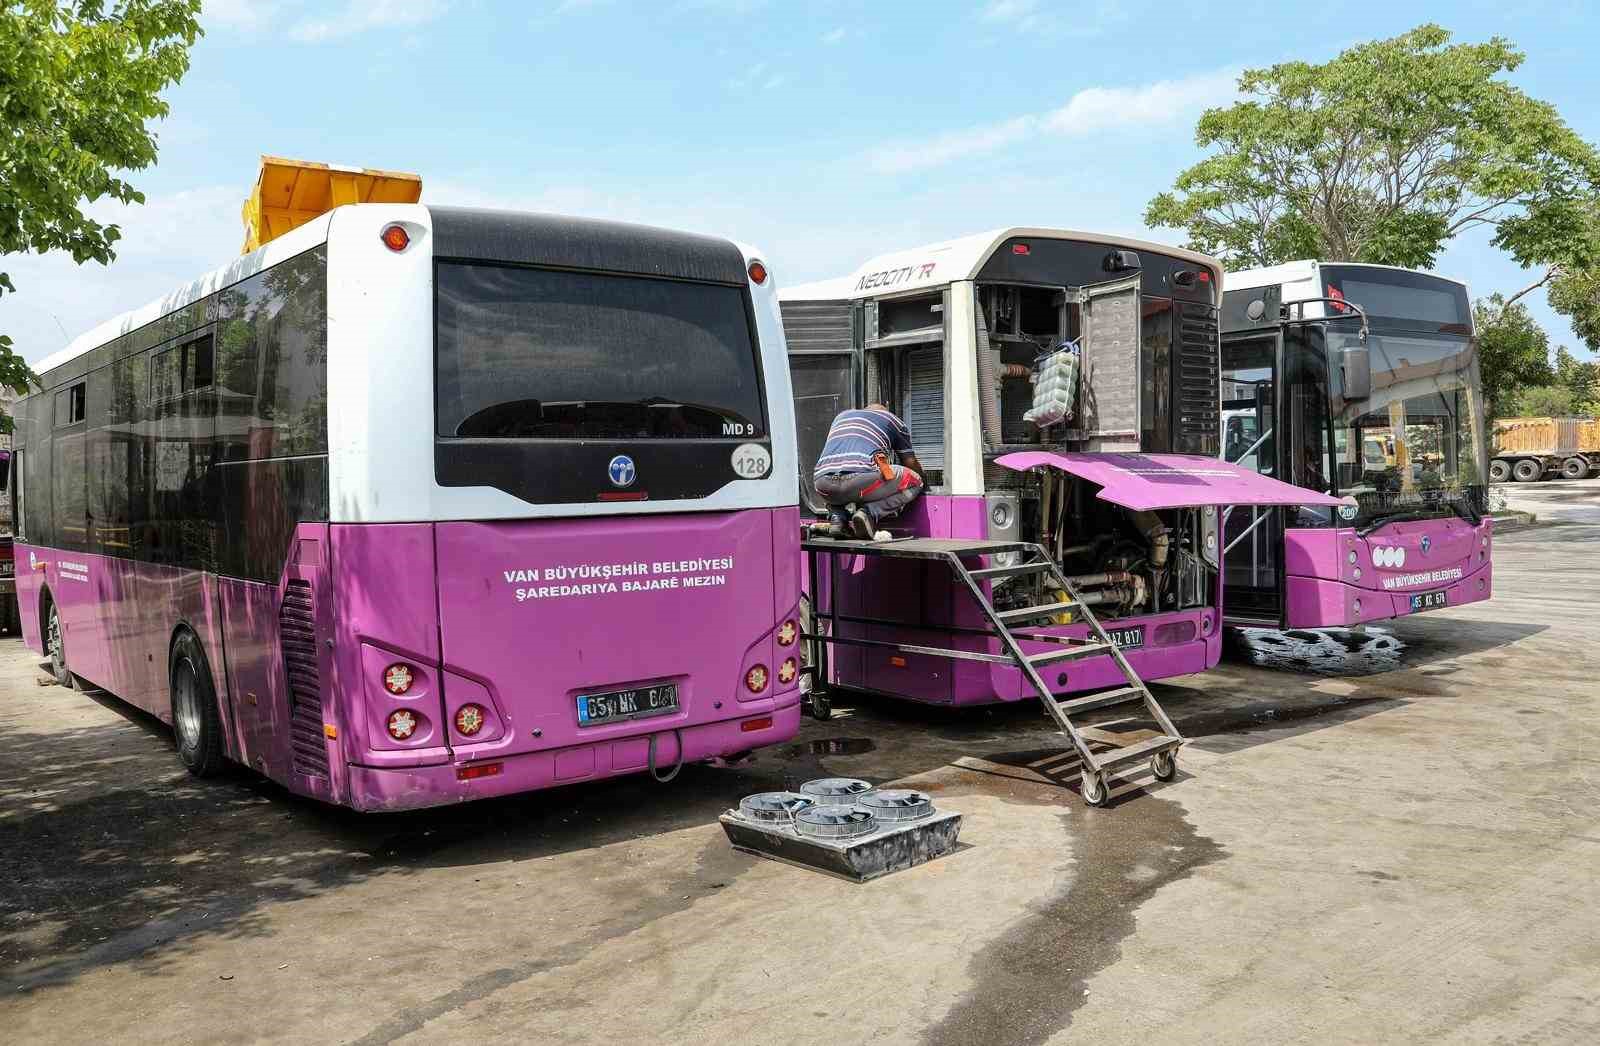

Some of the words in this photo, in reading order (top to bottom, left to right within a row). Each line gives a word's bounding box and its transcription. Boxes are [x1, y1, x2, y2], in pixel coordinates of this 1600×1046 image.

[855, 266, 912, 292] NEOCITY
[722, 423, 744, 435] MD
[746, 423, 754, 435] 9
[737, 457, 766, 474] 128
[503, 569, 540, 584] VAN
[545, 562, 648, 581] BÜYÜKŞEHİR
[653, 556, 734, 574] BELEDİYESİ
[1124, 629, 1139, 644] 817
